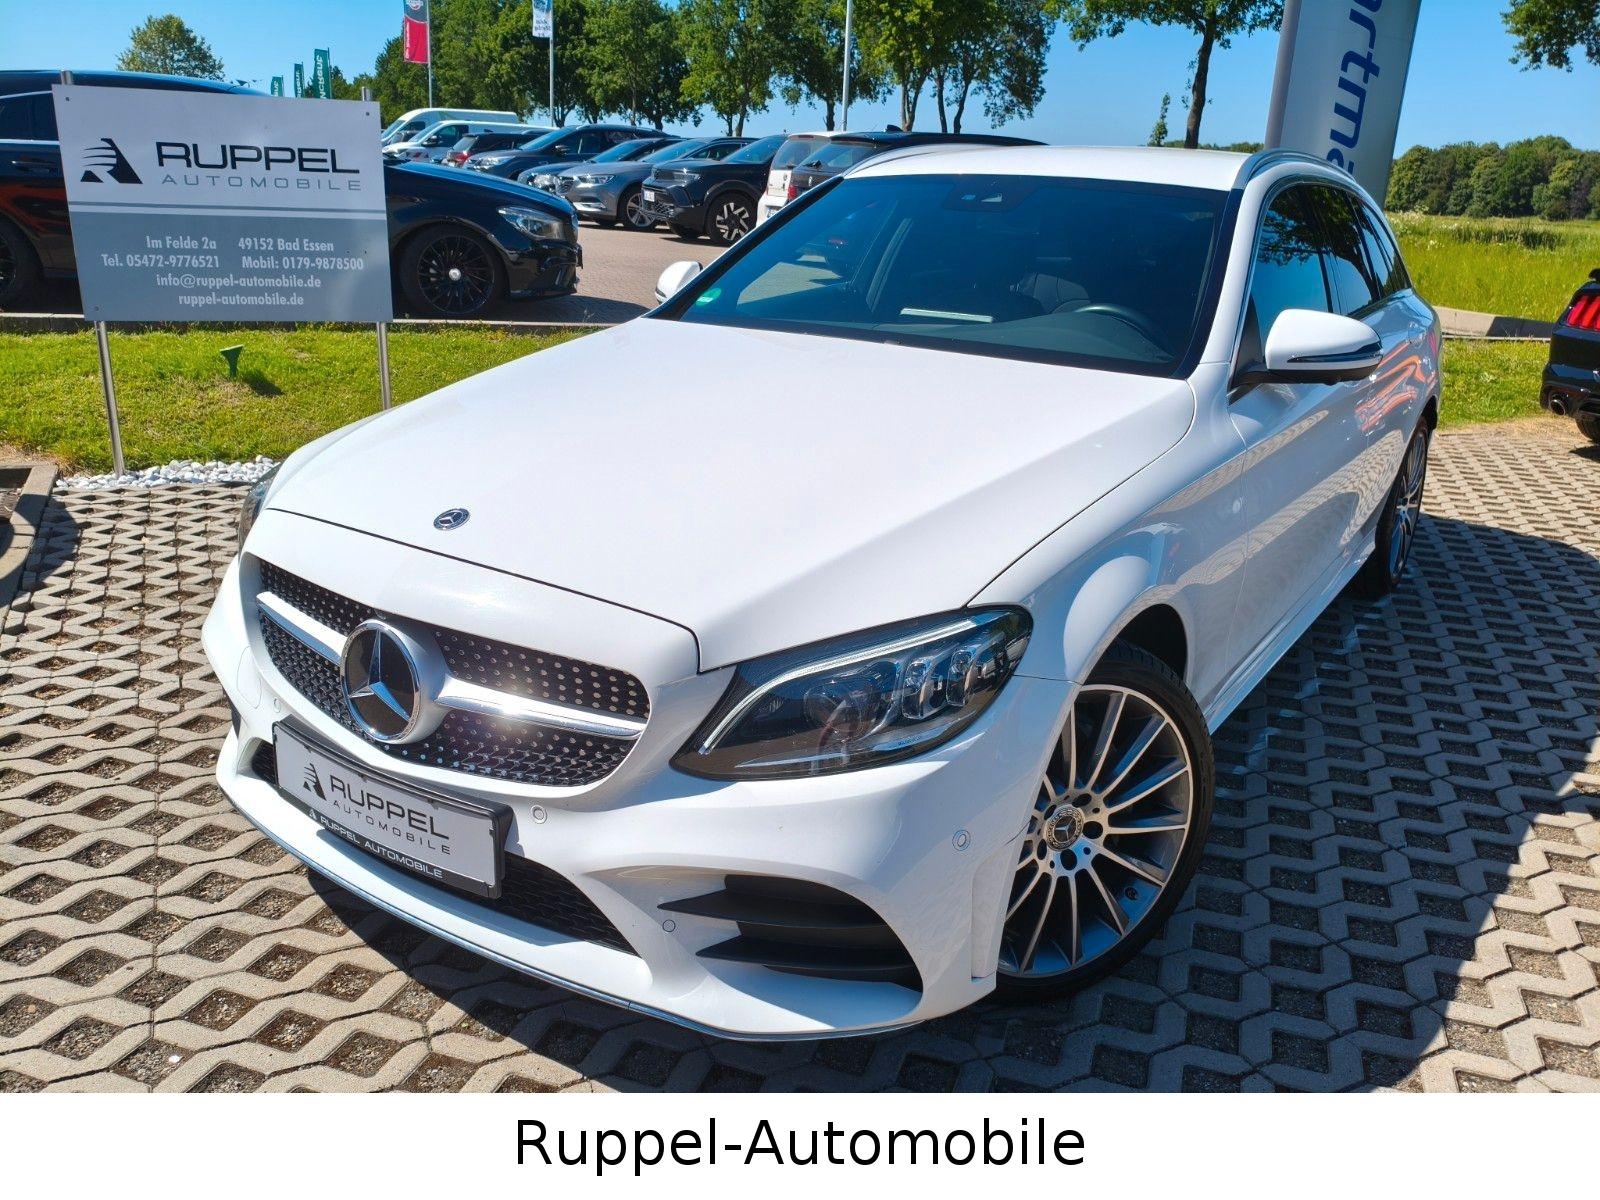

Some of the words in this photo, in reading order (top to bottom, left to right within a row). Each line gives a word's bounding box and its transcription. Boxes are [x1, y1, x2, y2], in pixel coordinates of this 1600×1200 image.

[155, 141, 361, 174] RUPPEL
[161, 174, 362, 191] AUTOMOBILE
[146, 235, 162, 248] Im
[165, 235, 198, 249] Felde
[201, 236, 217, 249] 2a
[238, 237, 274, 250] 49152
[277, 238, 300, 251] Bad
[303, 238, 334, 251] Essen
[101, 253, 123, 267] Tel.
[126, 254, 220, 268] 05472-9776521
[242, 256, 279, 269] Mobil:
[282, 257, 364, 270] 0179-9878500
[156, 273, 321, 289] info@ruppel-automobile.de
[178, 292, 304, 307] ruppel-automobile.de
[329, 774, 450, 840] RUPPEL
[332, 799, 451, 856] AUTOMOBILE
[320, 815, 361, 845] RUPPEL
[364, 840, 443, 879] AUTOMOBILE
